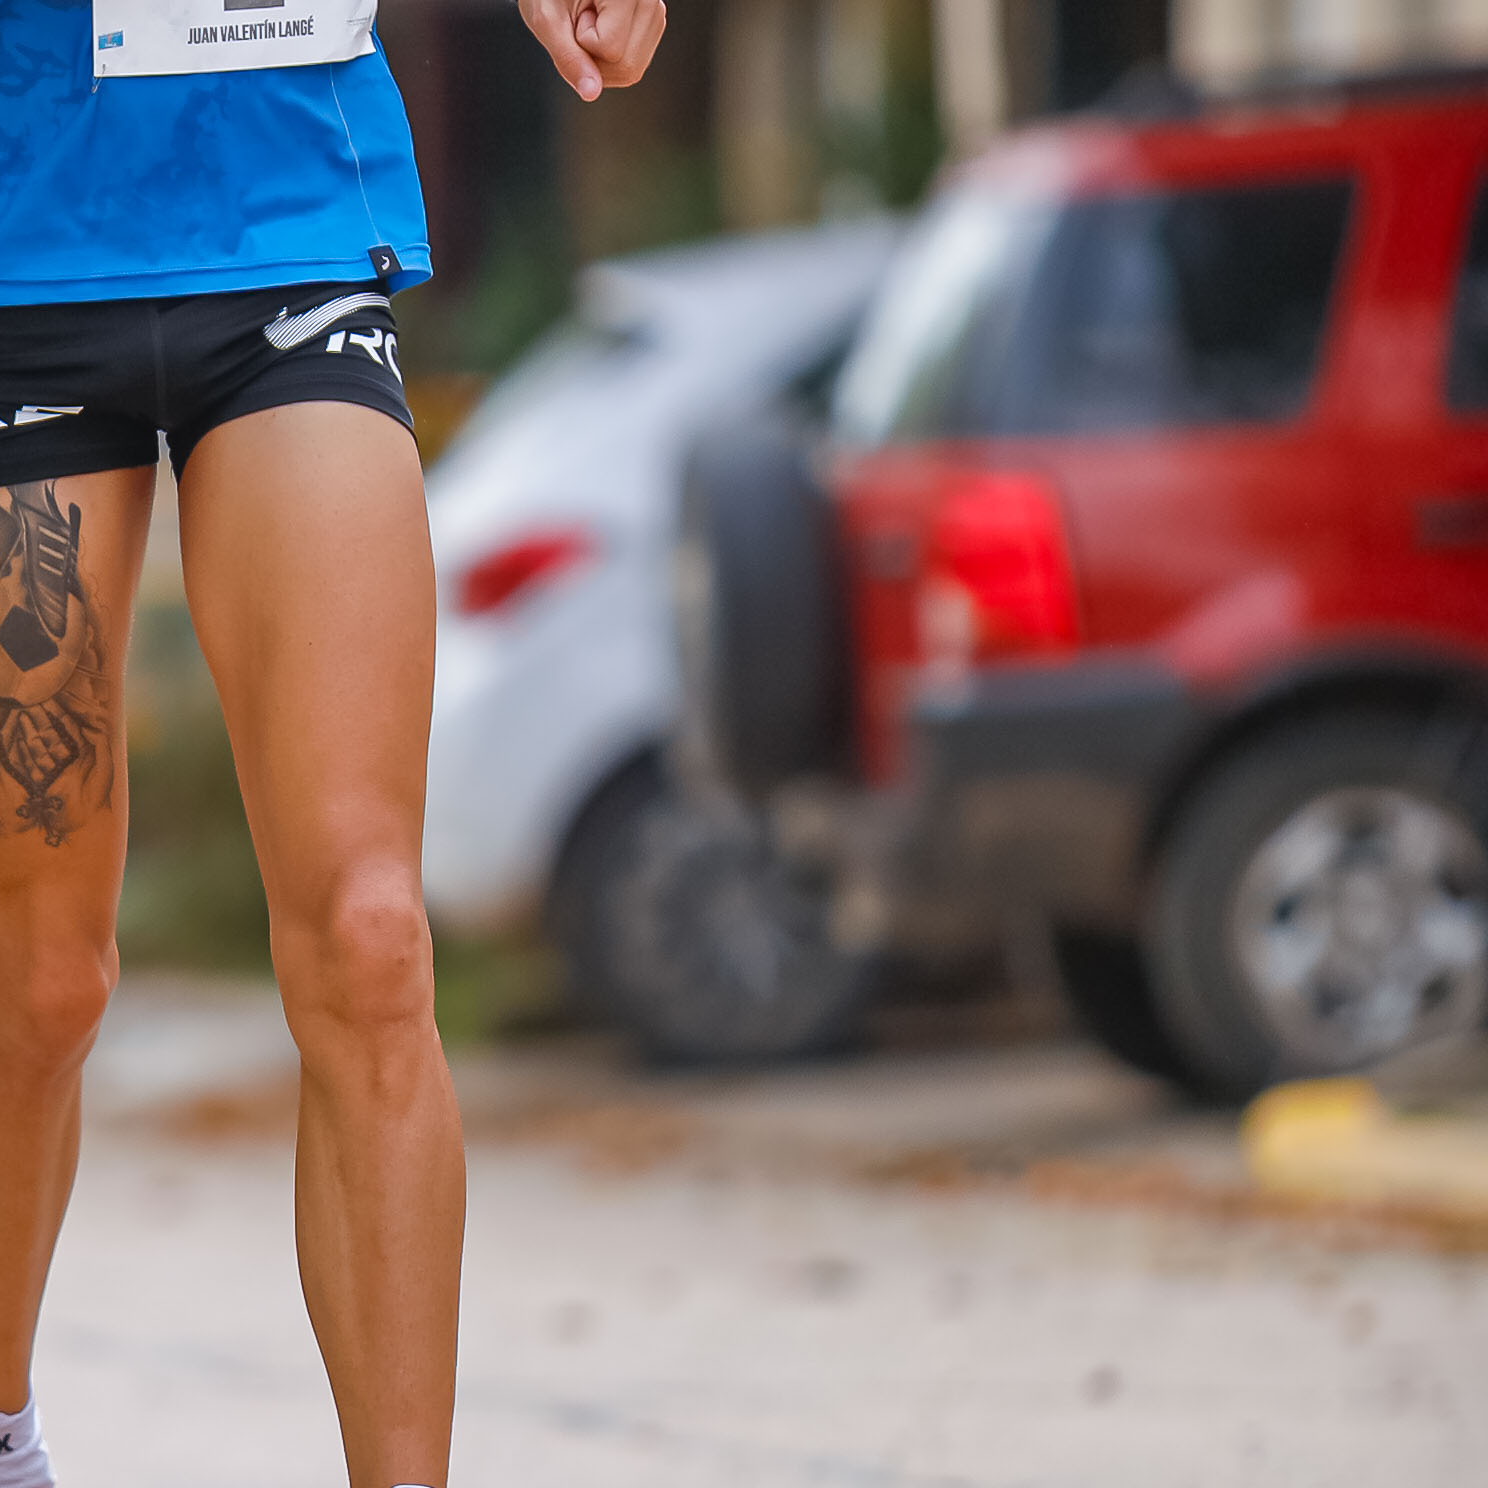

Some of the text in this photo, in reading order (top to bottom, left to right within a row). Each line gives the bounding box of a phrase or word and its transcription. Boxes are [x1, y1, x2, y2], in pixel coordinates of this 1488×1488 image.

[187, 15, 314, 44] JUAN VALENTÍN LANGÉ
